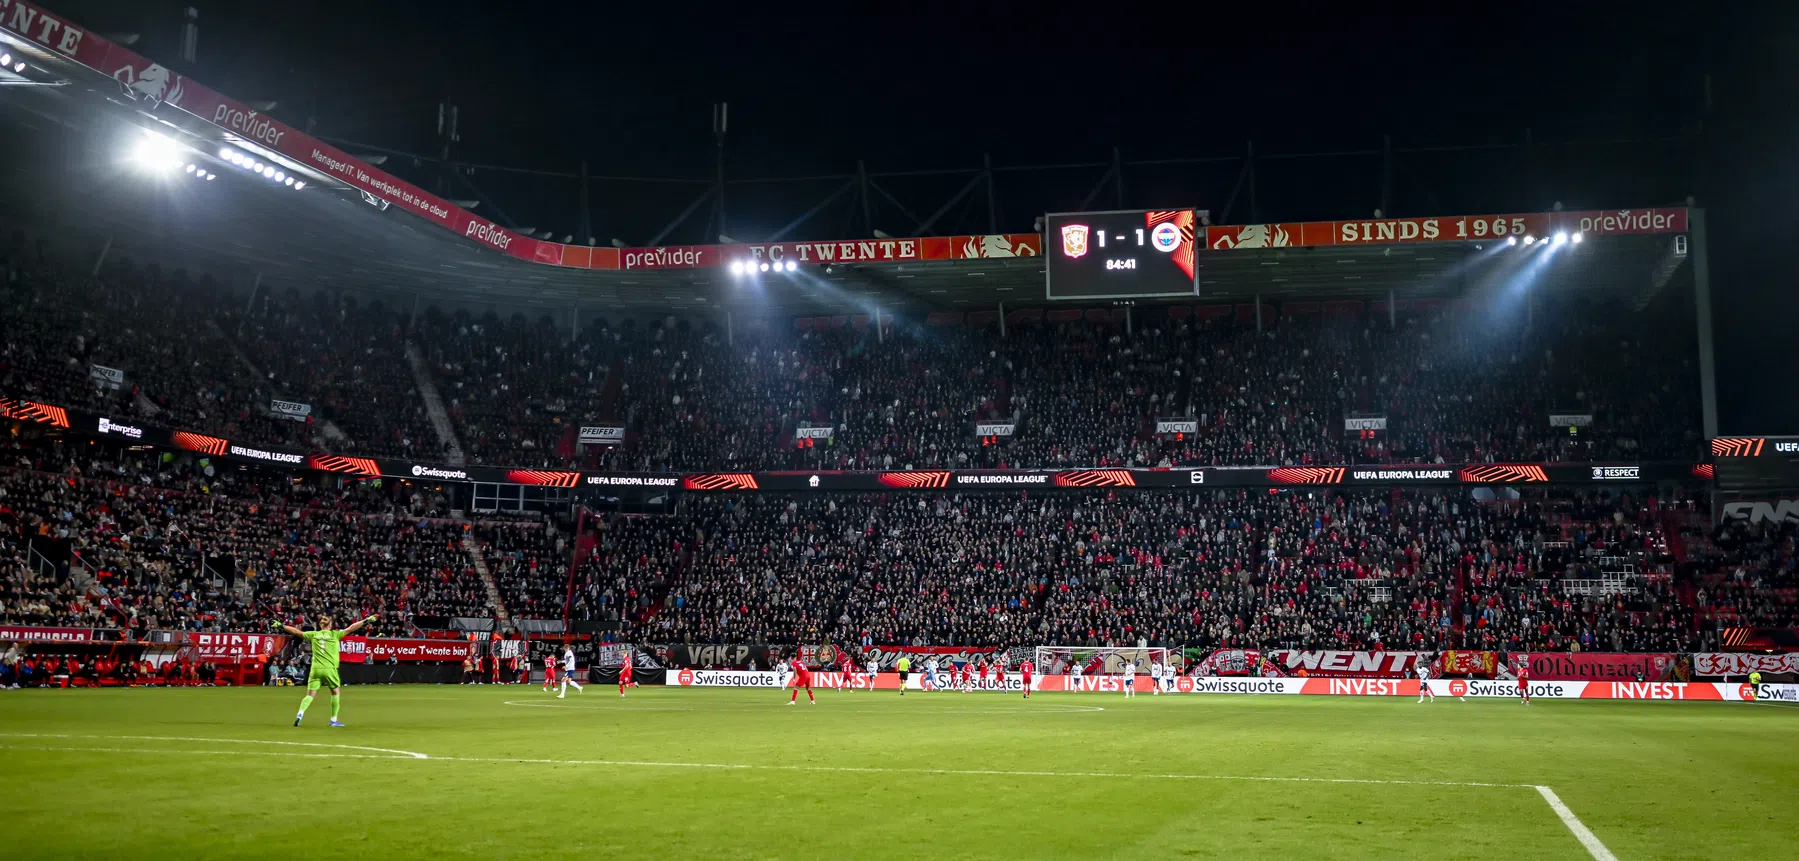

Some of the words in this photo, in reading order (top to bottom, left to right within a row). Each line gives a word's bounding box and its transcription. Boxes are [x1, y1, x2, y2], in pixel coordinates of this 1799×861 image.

[213, 103, 285, 146] previder
[312, 149, 346, 171] Managed
[346, 163, 355, 177] IT.
[356, 168, 369, 183] Van
[370, 177, 401, 199] werkplek
[402, 191, 413, 205] tot
[413, 195, 420, 206] in
[420, 199, 429, 211] de
[429, 203, 448, 219] cloud
[1341, 219, 1440, 242] SINDS
[1456, 217, 1526, 238] 1965
[1580, 209, 1675, 234] previder
[466, 220, 512, 250] previder
[1097, 230, 1106, 248] 1
[1135, 229, 1144, 246] 1
[625, 247, 703, 269] previder
[750, 246, 784, 262] FC
[796, 241, 915, 261] TWENTE
[1106, 259, 1136, 270] 84:41
[581, 427, 615, 435] PFEIFER
[982, 425, 1010, 435] VICTA
[1162, 422, 1192, 432] VICTA
[1351, 420, 1381, 429] VICTA
[802, 429, 831, 437] VICTA
[231, 445, 247, 455] UEFA
[247, 448, 271, 460] EUROPA
[272, 452, 302, 463] LEAGUE
[422, 466, 467, 480] Swissquote
[957, 476, 980, 484] UEFA
[981, 475, 1013, 484] EUROPA
[1014, 475, 1045, 483] LEAGUE
[1354, 471, 1377, 479] UEFA
[1379, 471, 1414, 479] EUROPA
[1415, 470, 1449, 479] LEAGUE
[1605, 468, 1639, 477] RESPECT
[588, 477, 610, 485] UEFA
[611, 477, 643, 485] EUROPA
[645, 477, 675, 486] LEAGUE
[397, 646, 416, 655] veur
[418, 645, 451, 656] Twente
[452, 646, 468, 657] bint
[687, 645, 751, 666] VAK-P
[1533, 656, 1652, 677] Oldenzaal
[695, 671, 774, 687] Swissquote
[1196, 678, 1284, 694] Swissquote
[1329, 679, 1401, 695] INVEST
[1611, 682, 1688, 699] INVEST
